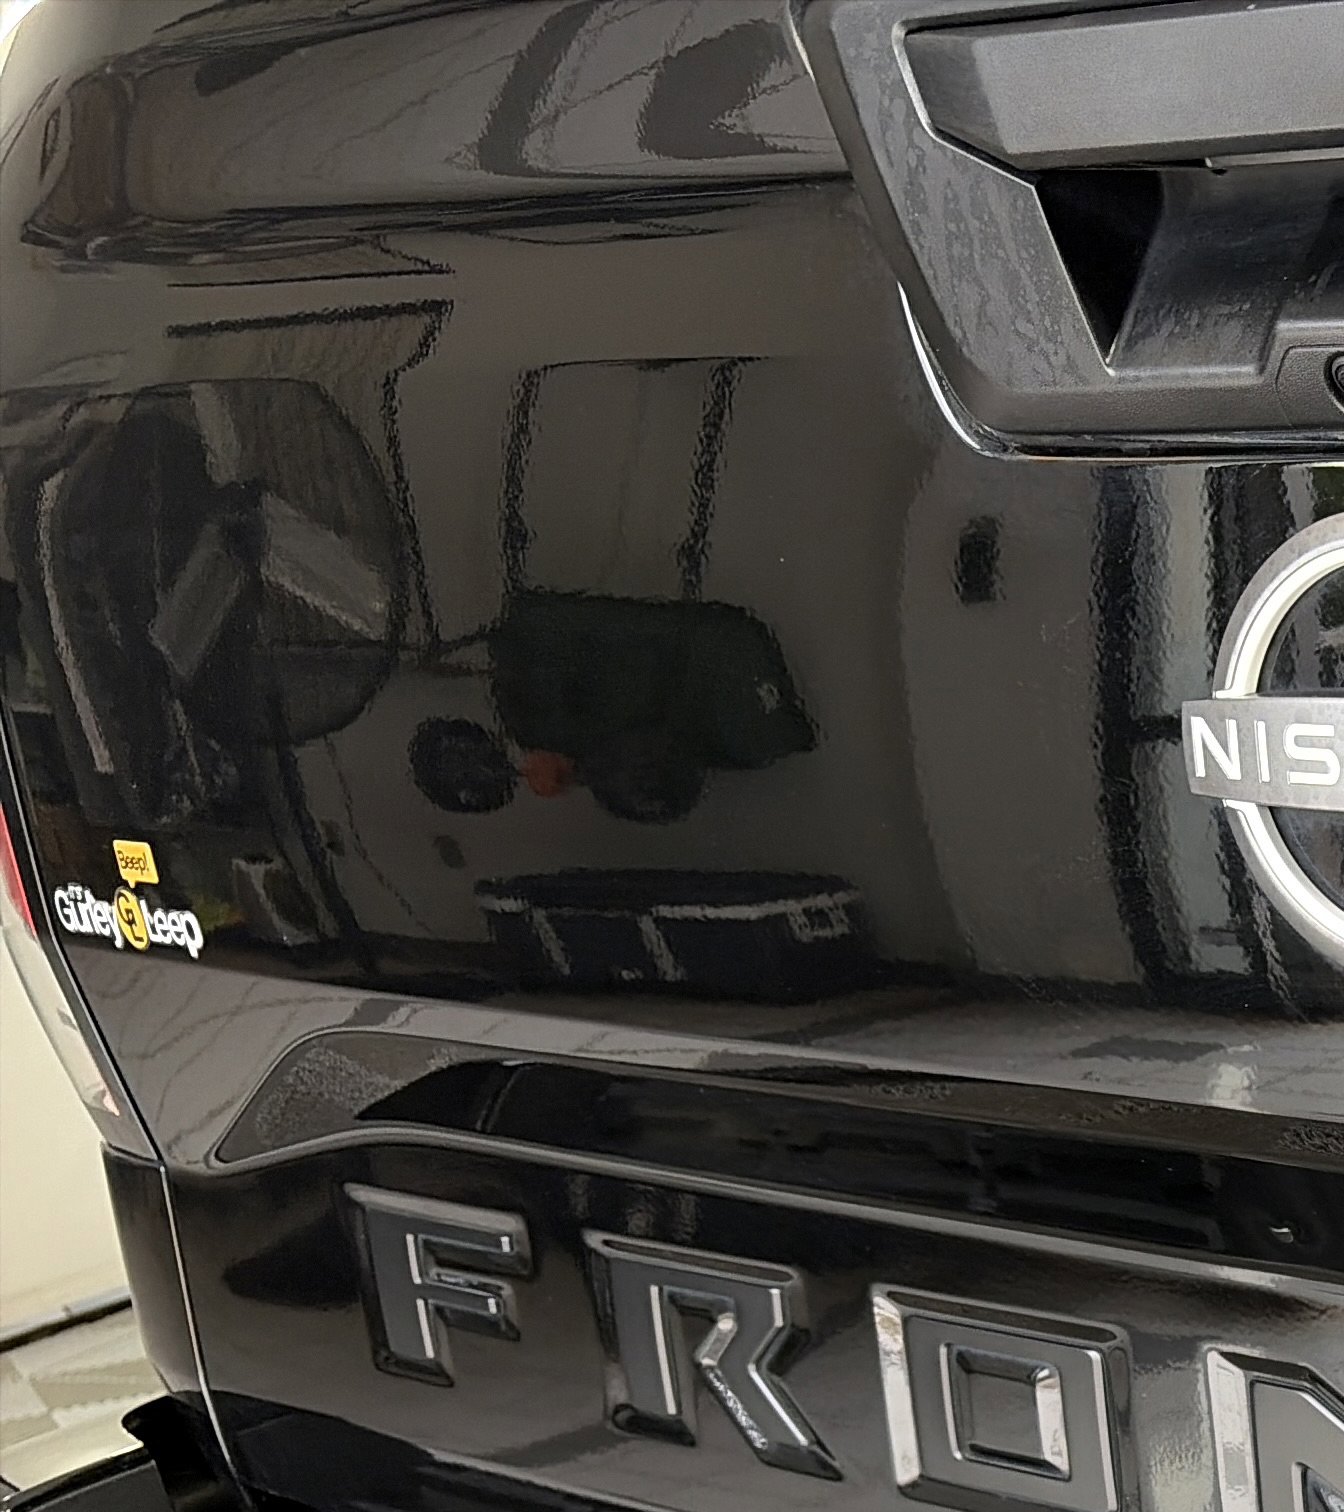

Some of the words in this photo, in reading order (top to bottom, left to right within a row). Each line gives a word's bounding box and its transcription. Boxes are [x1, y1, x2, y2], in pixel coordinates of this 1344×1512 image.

[116, 850, 150, 875] Beep!
[54, 887, 124, 949] Gurley
[139, 899, 204, 959] Leep
